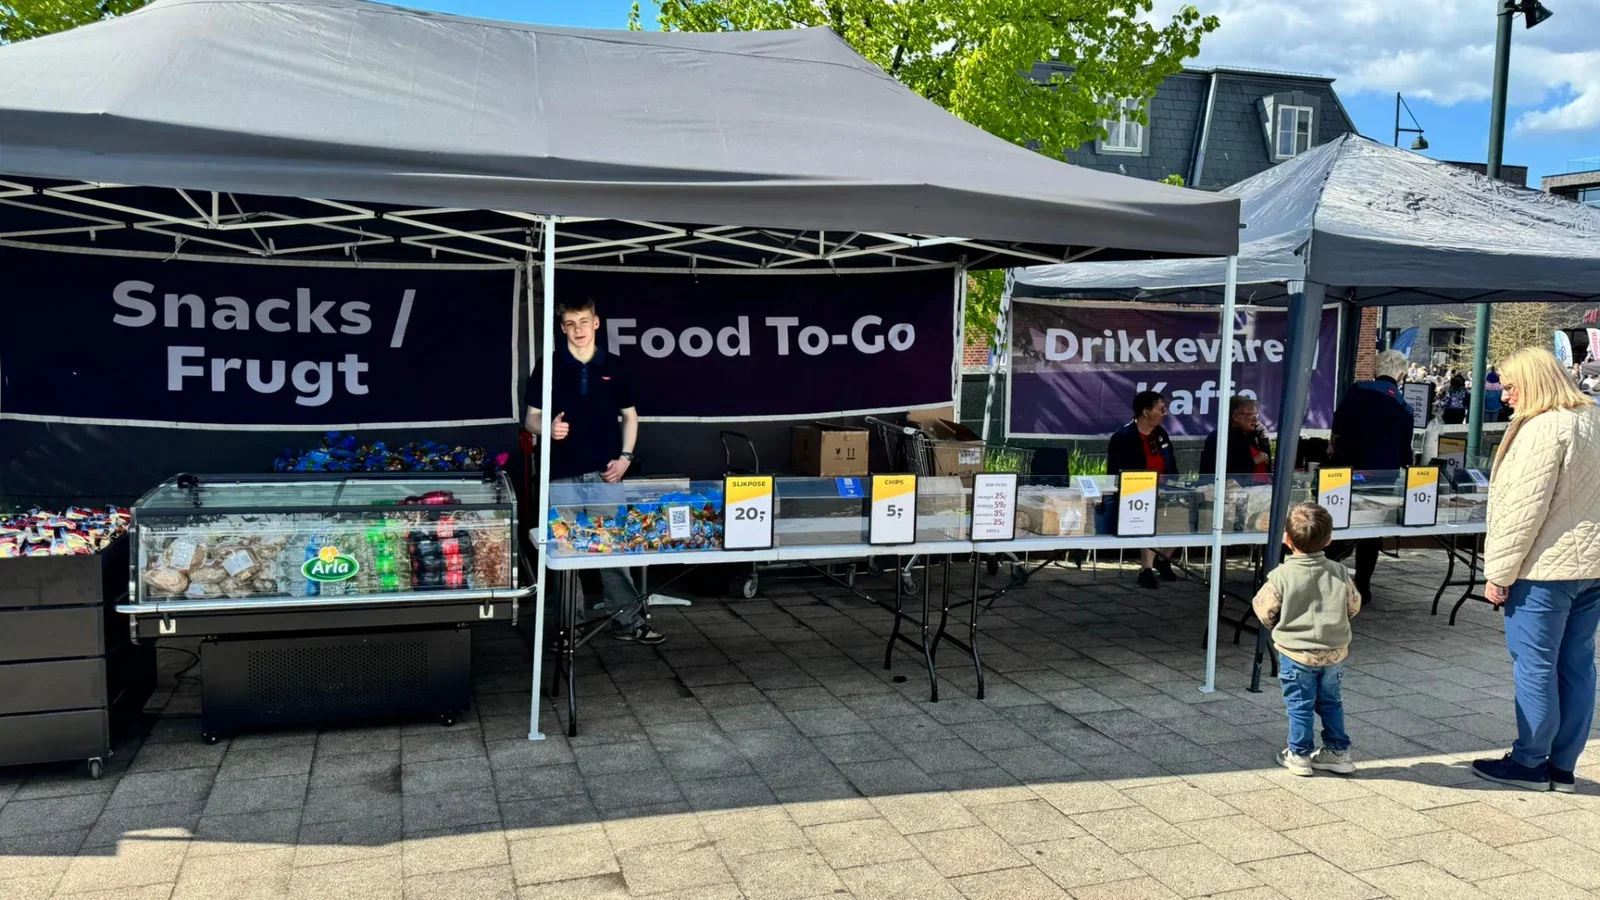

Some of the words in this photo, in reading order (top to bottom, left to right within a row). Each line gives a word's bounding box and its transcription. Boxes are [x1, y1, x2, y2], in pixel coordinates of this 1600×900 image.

[112, 279, 372, 335] Snacks
[390, 289, 416, 348] /
[606, 315, 750, 359] Food
[765, 314, 916, 356] To-Go
[1045, 328, 1287, 363] Drikkevare
[167, 345, 370, 407] Frugt
[311, 558, 349, 575] Arla
